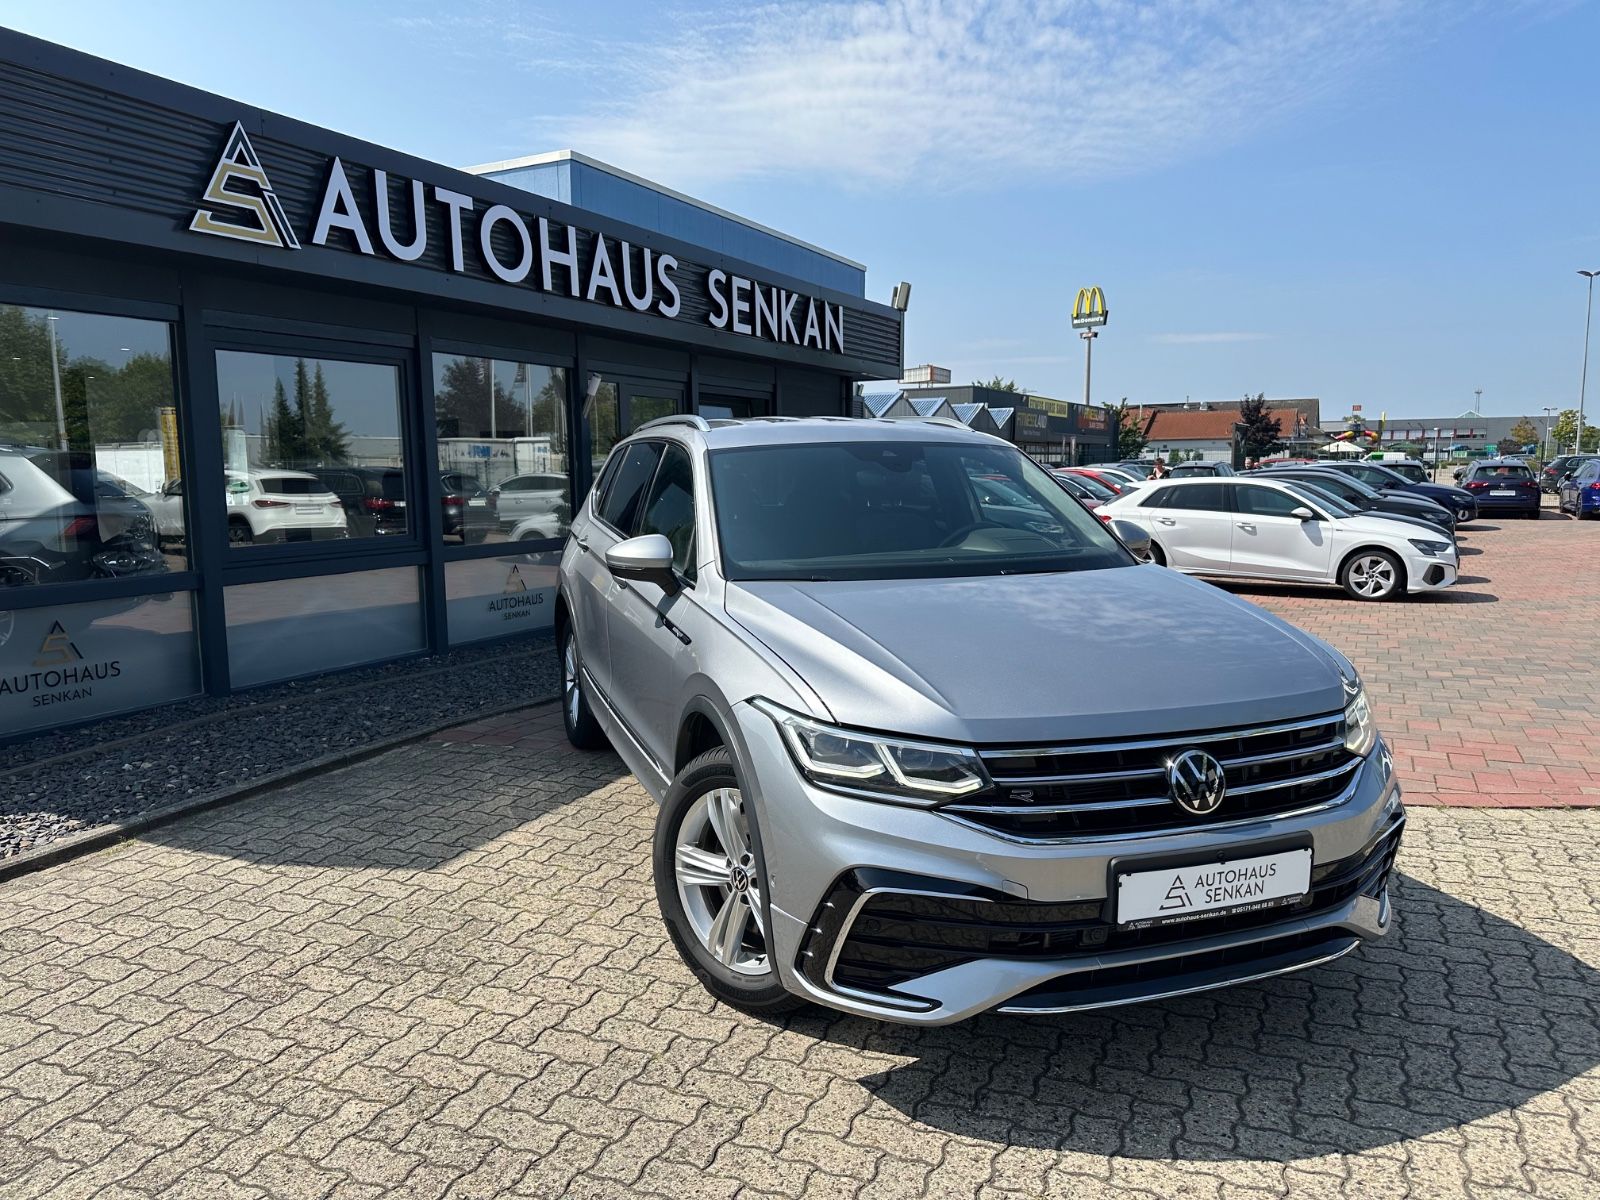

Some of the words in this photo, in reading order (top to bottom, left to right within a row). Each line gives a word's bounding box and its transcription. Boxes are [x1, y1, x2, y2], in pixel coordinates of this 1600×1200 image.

[312, 156, 681, 318] AUTOHAUS
[708, 268, 844, 354] SENKAN
[489, 593, 544, 612] AUTOHAUS
[504, 609, 531, 620] SENKAN
[0, 660, 121, 695] AUTOHAUS
[32, 686, 93, 707] SENKAN
[1195, 863, 1277, 889] AUTOHAUS
[1204, 880, 1265, 904] SENKAN
[1161, 909, 1227, 925] www.autohaus-senkan.de
